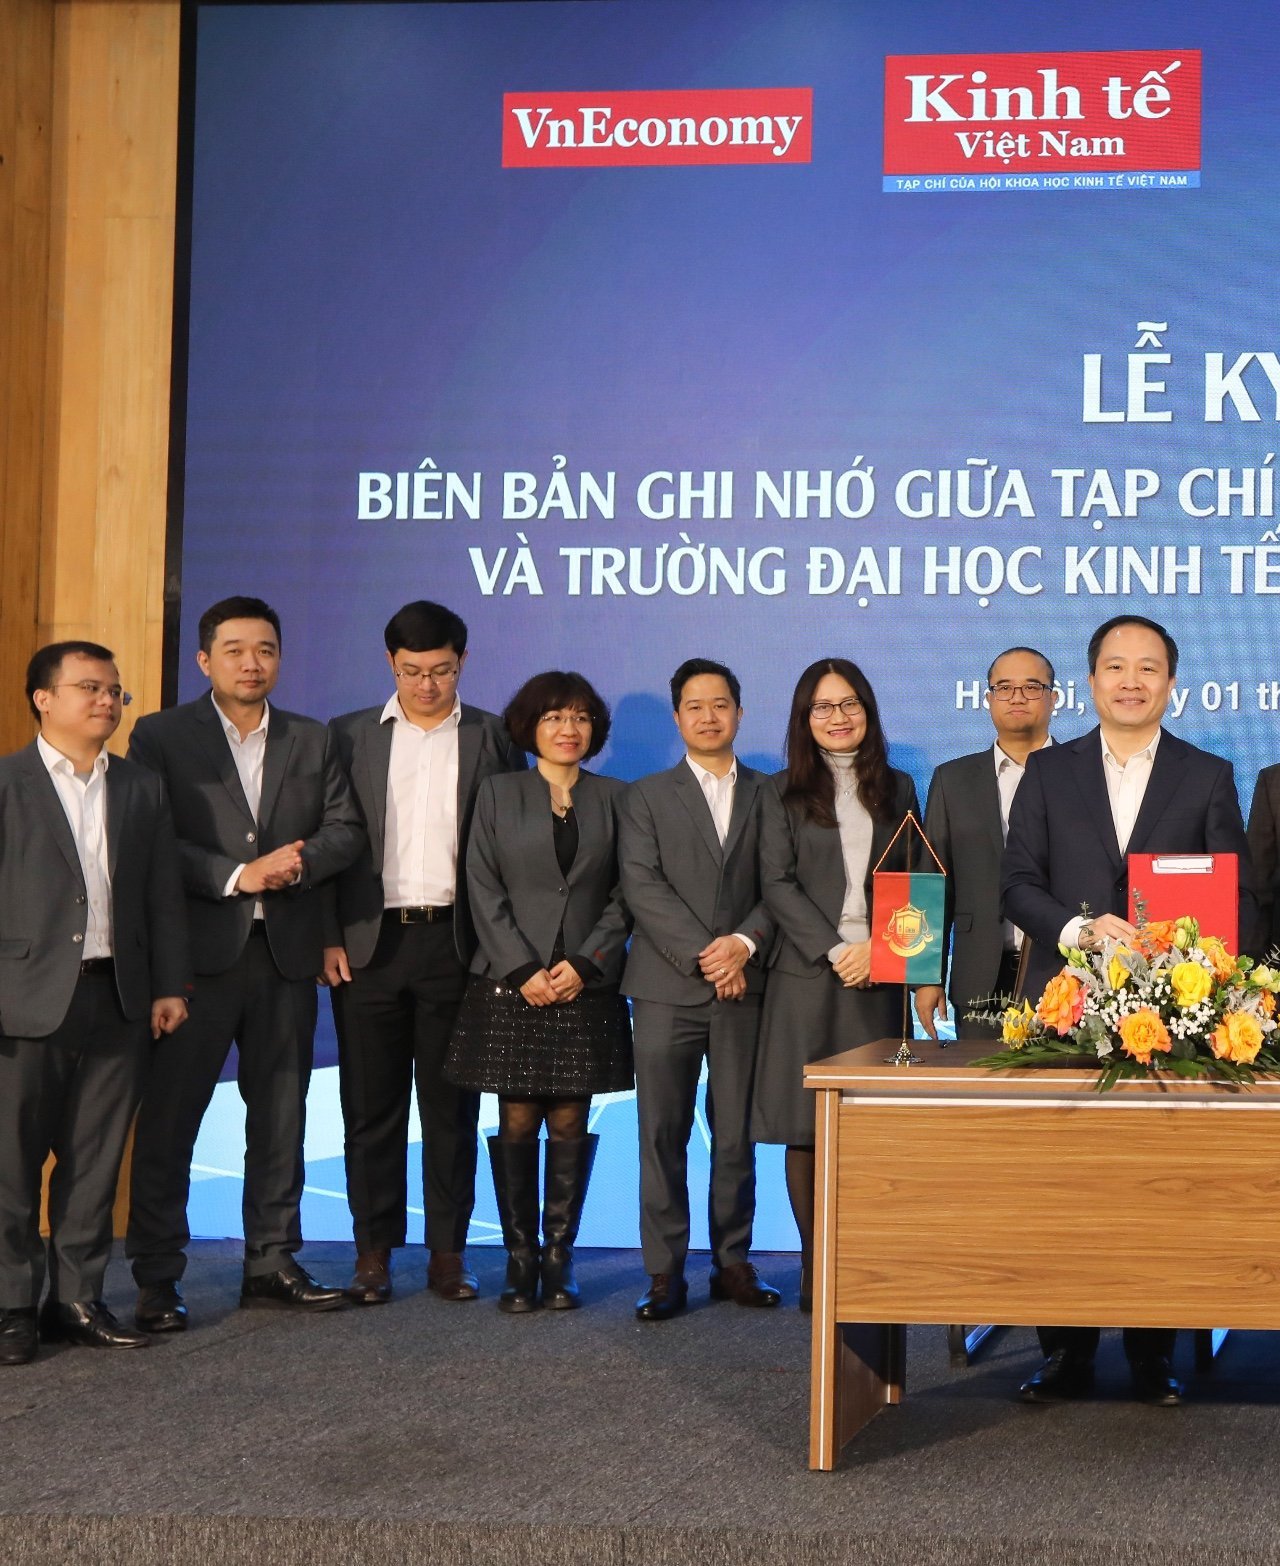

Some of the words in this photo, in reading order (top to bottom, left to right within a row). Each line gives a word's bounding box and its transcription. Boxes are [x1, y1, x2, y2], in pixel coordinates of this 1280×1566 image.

[904, 69, 1086, 123] Kinh
[1102, 60, 1182, 120] tế
[511, 107, 803, 157] VnEconomy
[953, 130, 1031, 164] Việt
[1037, 130, 1126, 157] Nam
[896, 179, 921, 191] TẠP
[924, 177, 947, 189] CHÍ
[950, 177, 976, 189] CỦA
[979, 177, 1001, 190] HỘI
[1005, 178, 1039, 188] KHOA
[1043, 177, 1070, 189] HỌC
[1073, 176, 1104, 187] KINH
[1107, 174, 1126, 187] TẾ
[1127, 174, 1156, 188] VIỆT
[1159, 175, 1188, 186] NAM
[1082, 321, 1172, 423] LỄ
[357, 457, 482, 520] BIÊN
[502, 454, 616, 519] BẢN
[637, 471, 733, 520] GHI
[755, 455, 875, 519] NHỚ
[895, 457, 1036, 518] GIỮA
[1052, 468, 1160, 529] TẠP
[1178, 452, 1275, 519] CHÍ
[468, 534, 544, 596] VÀ
[559, 532, 786, 598] TRƯỜNG
[806, 547, 902, 608] ĐẠI
[923, 547, 1043, 608] HỌC
[1064, 545, 1201, 596] KINH
[955, 680, 990, 710] H
[1201, 681, 1239, 711] 01
